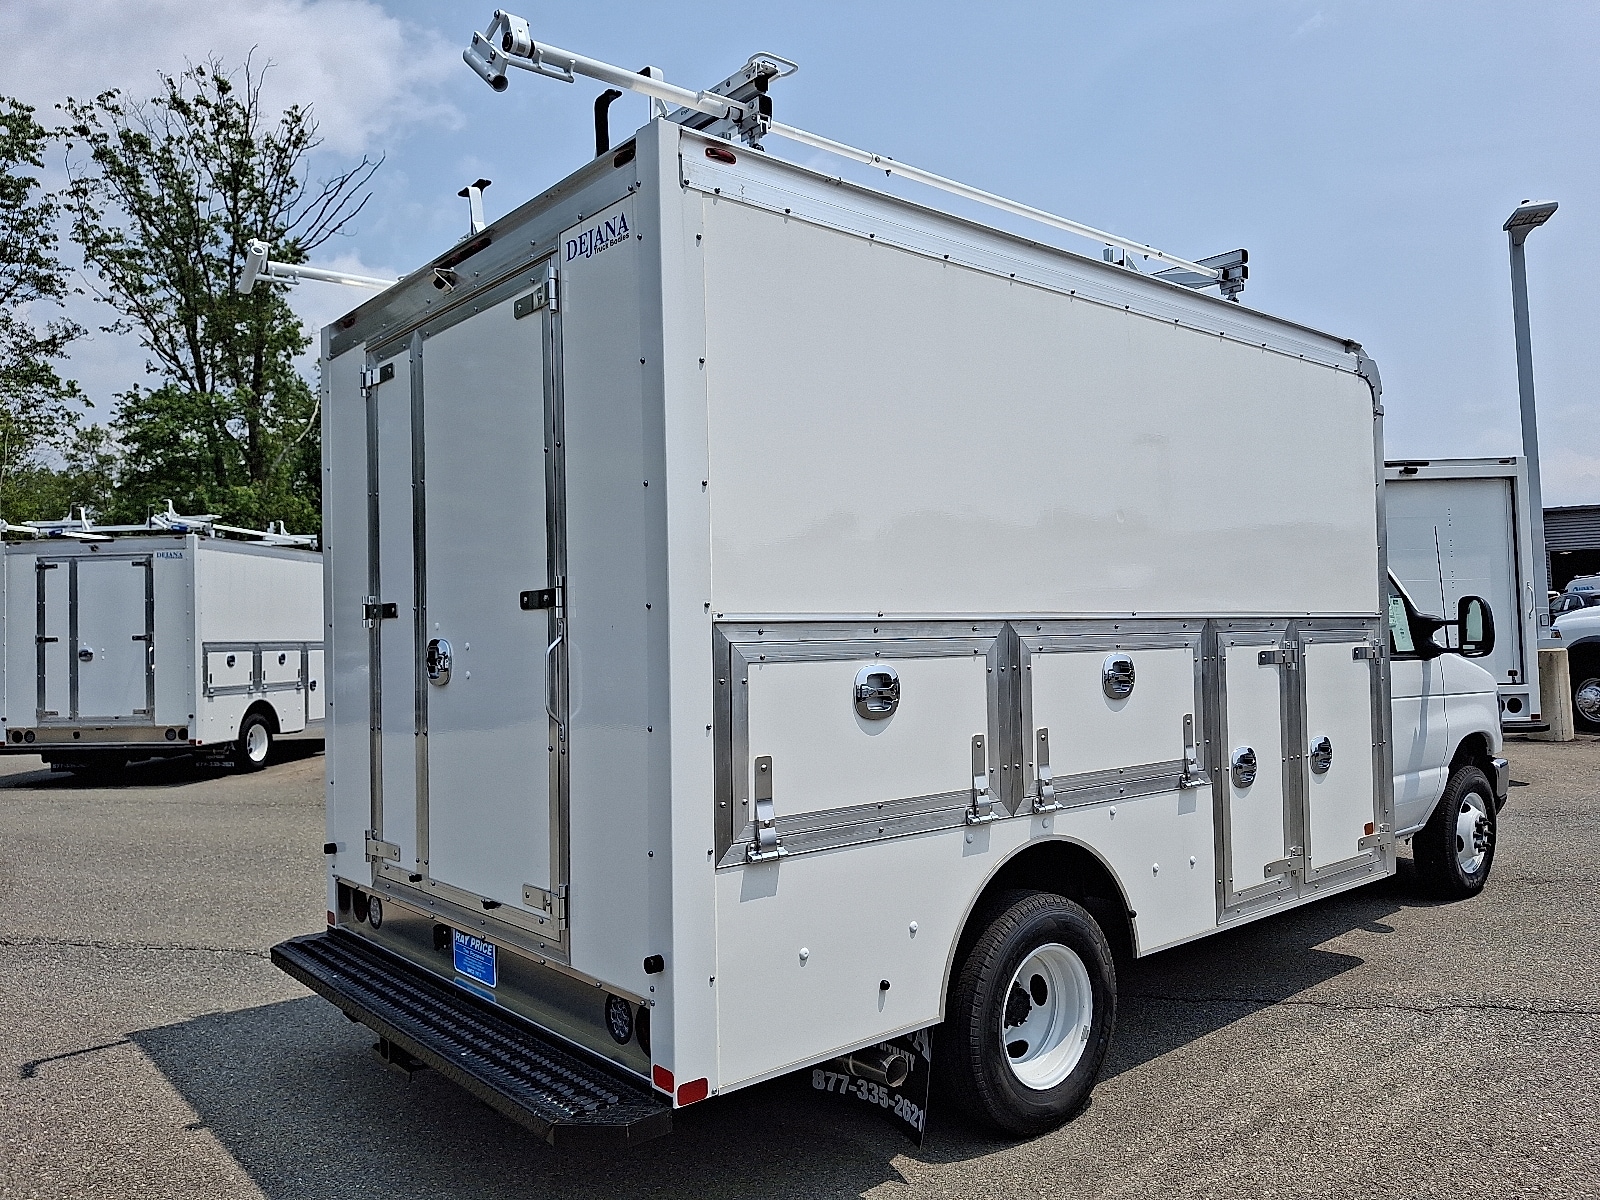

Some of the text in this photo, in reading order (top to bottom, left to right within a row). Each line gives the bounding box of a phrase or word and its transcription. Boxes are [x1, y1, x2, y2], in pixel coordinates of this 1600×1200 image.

[566, 212, 629, 262] DEJANA
[594, 233, 629, 254] Truck Bodies
[455, 931, 493, 955] RAY PRICE
[812, 1069, 924, 1132] 877-335-2621
